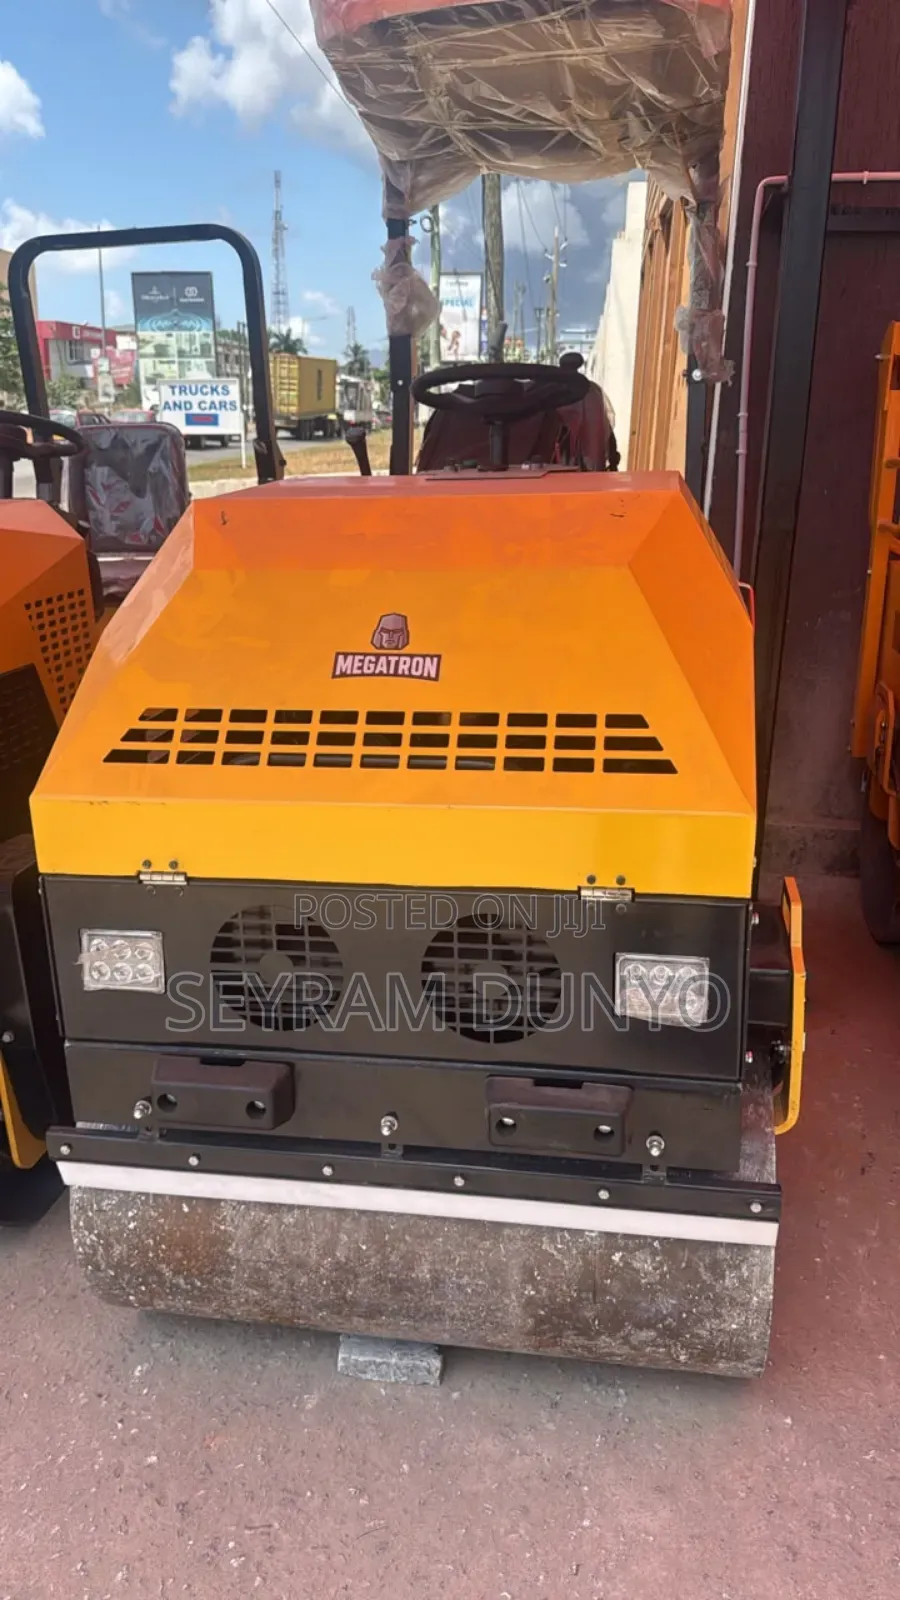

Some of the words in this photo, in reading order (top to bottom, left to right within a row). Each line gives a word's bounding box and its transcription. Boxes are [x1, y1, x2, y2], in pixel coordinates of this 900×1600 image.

[168, 383, 231, 397] TRUCKS
[162, 399, 193, 412] AND
[198, 400, 238, 412] CARS
[334, 654, 439, 679] MEGATRON
